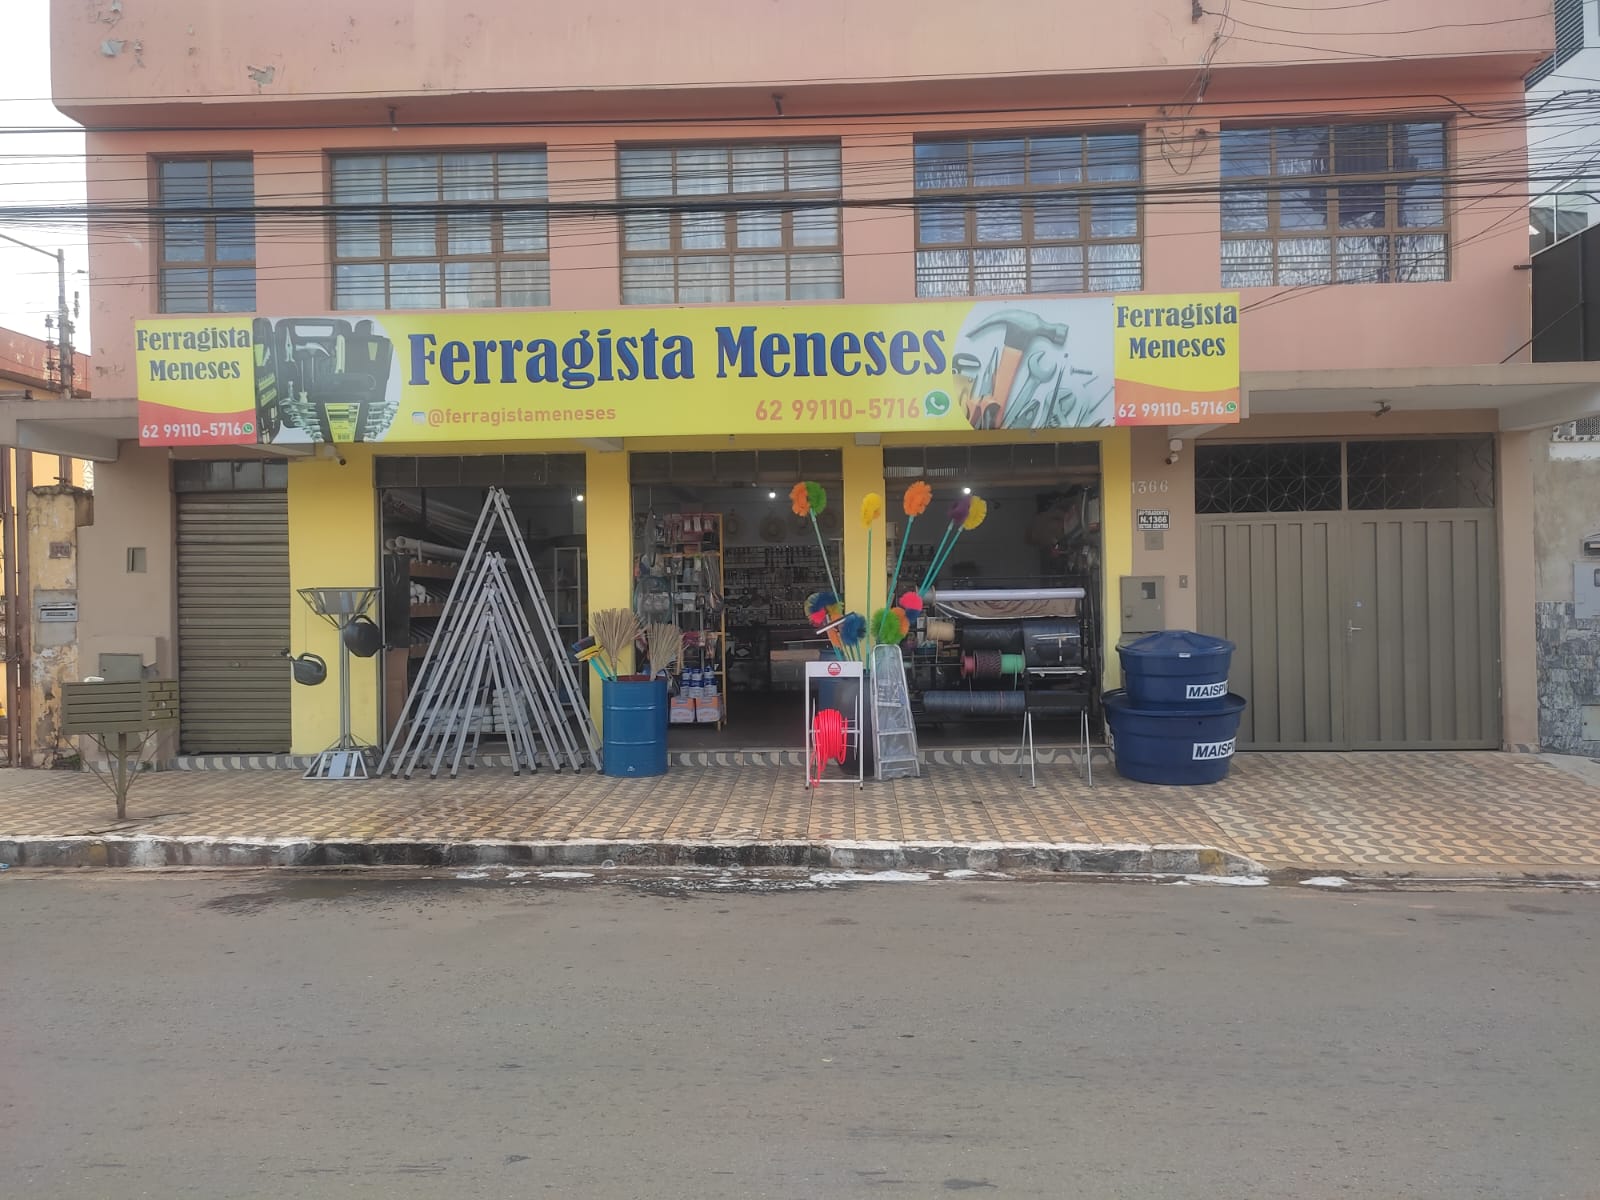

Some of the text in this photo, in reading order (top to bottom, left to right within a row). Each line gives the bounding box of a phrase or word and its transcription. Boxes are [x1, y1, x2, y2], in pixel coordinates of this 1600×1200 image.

[1117, 303, 1237, 328] Ferragista
[137, 327, 251, 352] Ferragista
[1129, 336, 1226, 359] Meneses
[408, 325, 947, 390] Ferragista Meneses
[149, 360, 241, 381] Meneses
[428, 407, 616, 427] @ferragistameneses
[755, 397, 920, 421] 62 99110-5716
[1118, 401, 1224, 418] 62 99110-5716
[142, 422, 242, 438] 62 99110-5716
[1132, 480, 1168, 494] 1366
